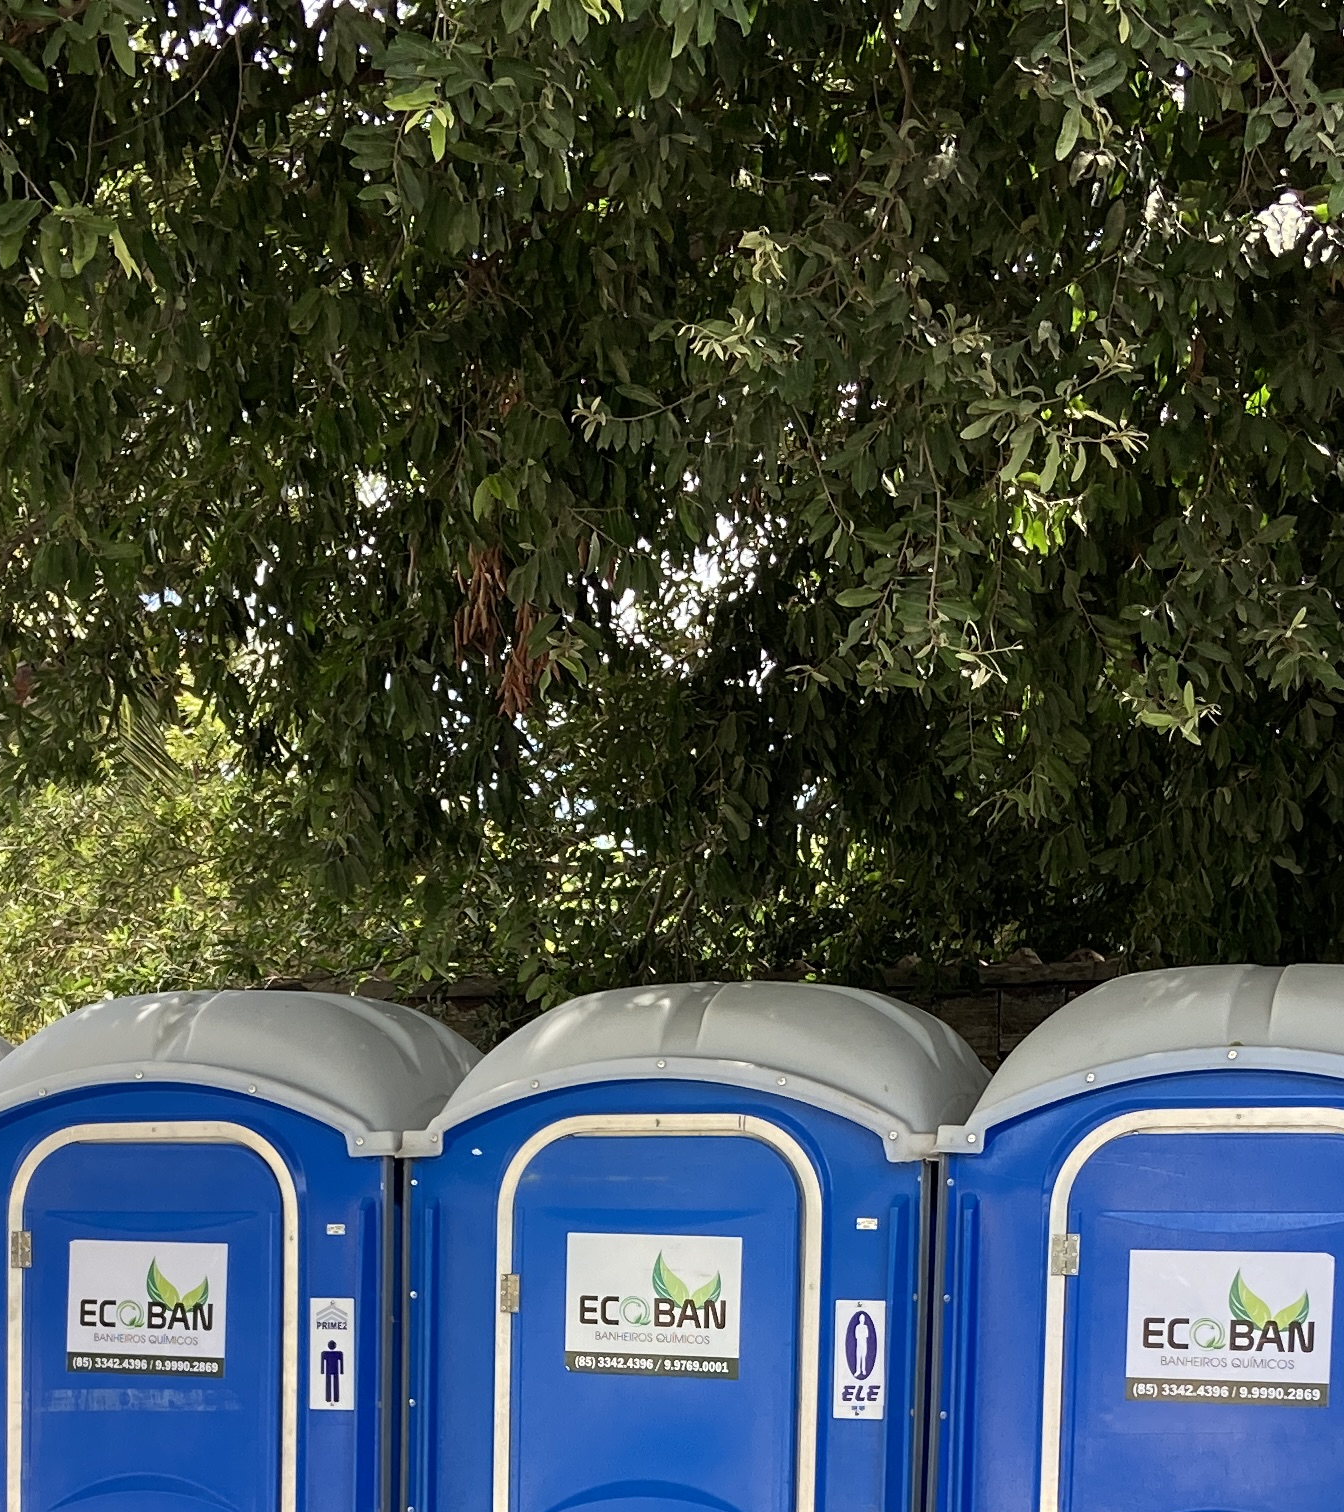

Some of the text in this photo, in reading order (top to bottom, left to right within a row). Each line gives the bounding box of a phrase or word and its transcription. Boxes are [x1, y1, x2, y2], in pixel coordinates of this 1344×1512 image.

[79, 1298, 213, 1331] ECOBAN
[579, 1294, 726, 1330] ECOBAN
[316, 1320, 348, 1330] PRIME2
[93, 1332, 199, 1346] BANHEIROS QUÍMICOS
[595, 1331, 710, 1345] BANHEIROS QUÍMICOS
[1142, 1316, 1315, 1353] ECOBAN
[73, 1356, 92, 1370] (85)
[95, 1357, 148, 1371] 3342.4396
[155, 1359, 219, 1373] 9.9990.2869
[575, 1355, 596, 1370] (85)
[597, 1356, 654, 1371] 3342.4396
[664, 1358, 729, 1373] 9.9769.0001
[1160, 1354, 1295, 1370] BANHEIROS QUÍMICOS
[841, 1385, 881, 1402] ELE
[1132, 1382, 1158, 1397] (85)
[1161, 1383, 1229, 1398] 3342.4396
[1239, 1385, 1321, 1402] 9.9990.2869
